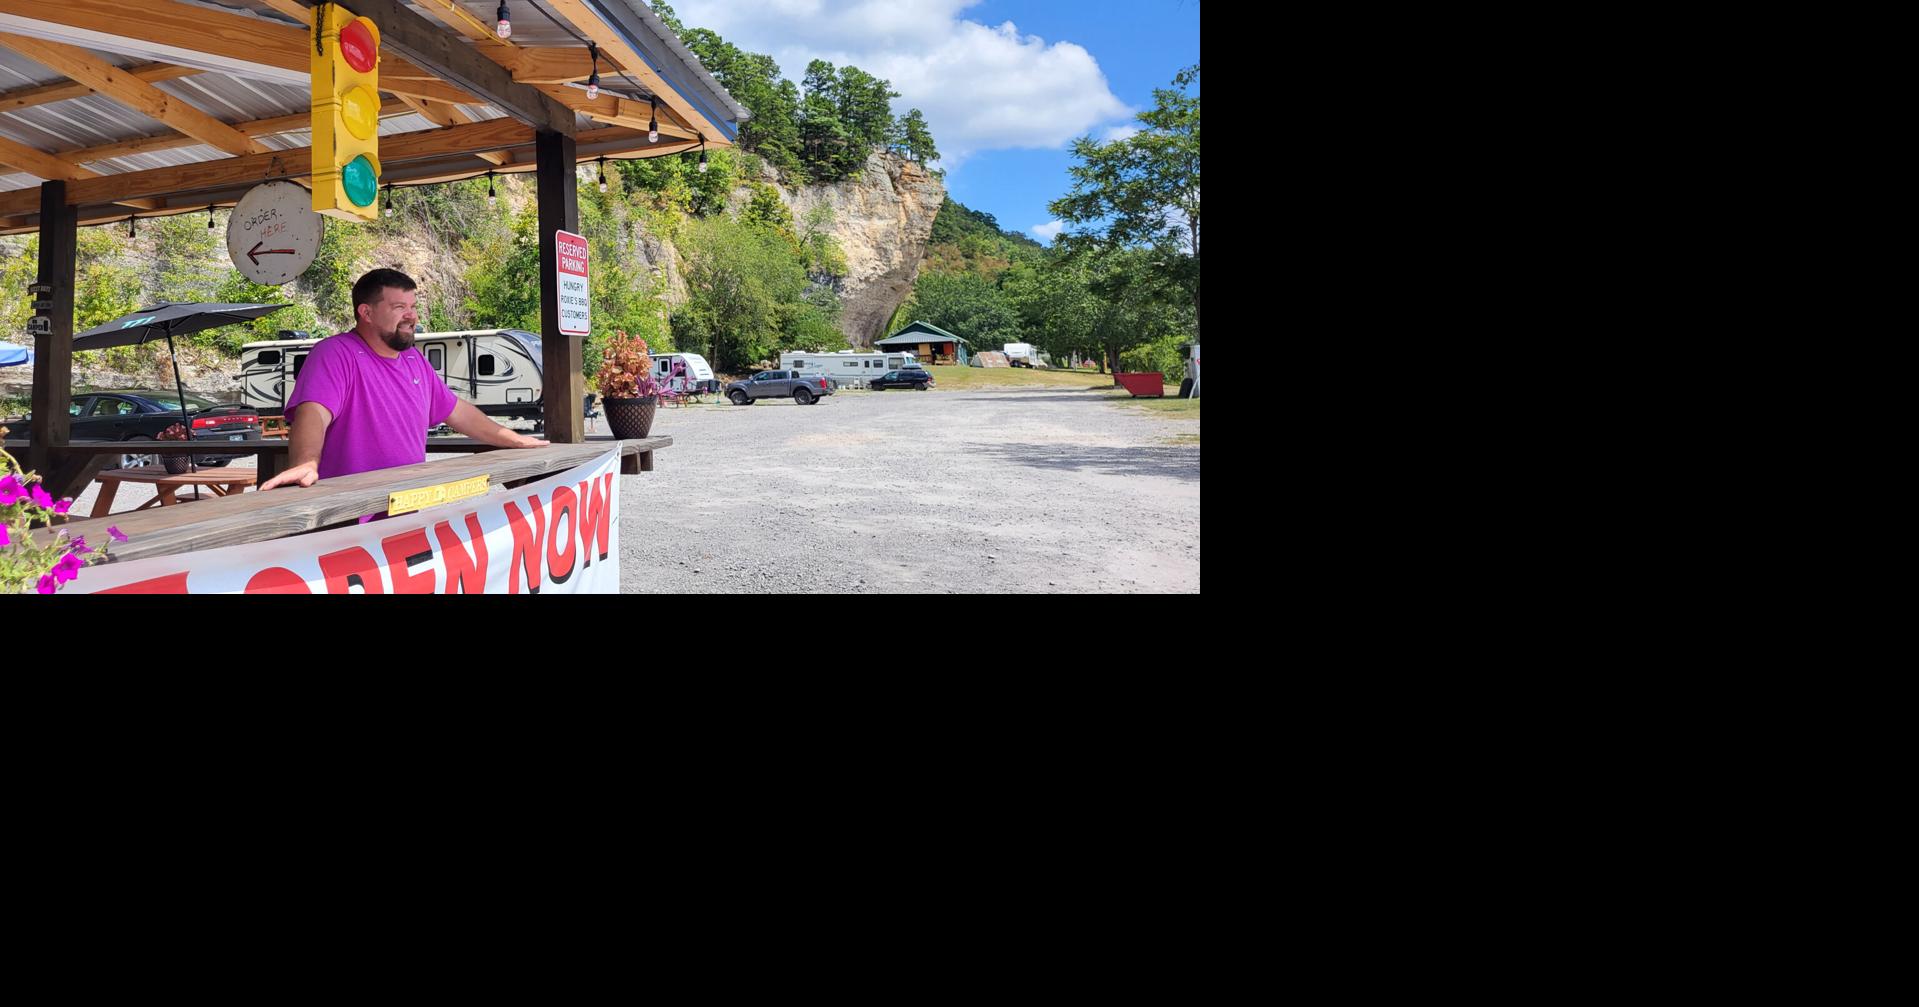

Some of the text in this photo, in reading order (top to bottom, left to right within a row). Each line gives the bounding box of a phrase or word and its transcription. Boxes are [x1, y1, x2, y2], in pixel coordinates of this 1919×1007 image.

[244, 208, 278, 230] ORDER
[260, 221, 287, 239] HERE
[558, 241, 587, 260] RESERVED
[561, 256, 585, 273] PARKING
[563, 280, 584, 292] HUNGRY
[578, 297, 588, 307] BBQ
[561, 308, 588, 320] CUSTOMERS
[396, 491, 433, 507] HAPPY
[244, 472, 614, 594] PEN NOW
